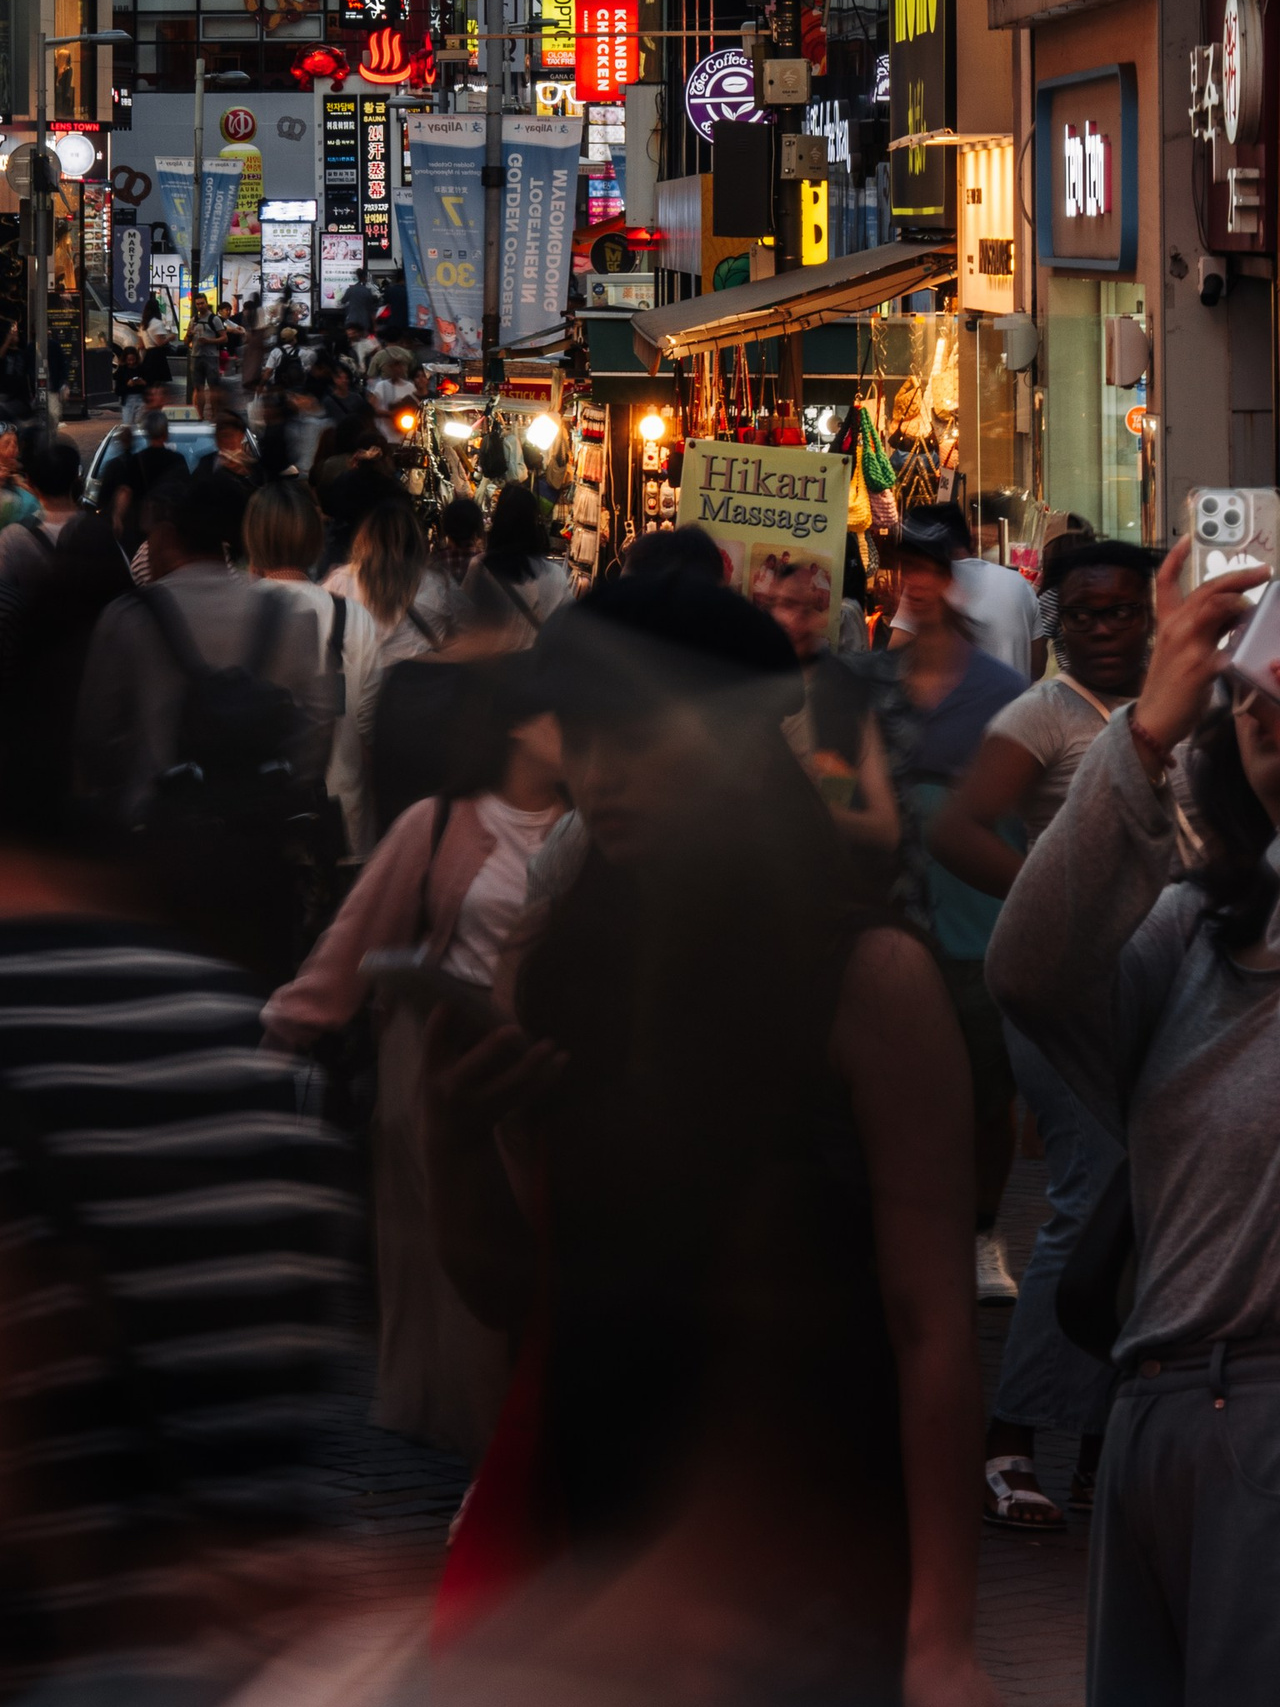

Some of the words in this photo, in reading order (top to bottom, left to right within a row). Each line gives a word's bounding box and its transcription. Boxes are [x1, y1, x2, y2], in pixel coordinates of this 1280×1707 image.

[596, 8, 610, 91] CHICKEN
[614, 8, 627, 82] KKANBU
[689, 71, 709, 96] The
[705, 52, 748, 74] Coffee
[326, 102, 355, 112] 전자담배
[363, 102, 386, 114] 황금
[363, 115, 387, 123] SAUNA
[51, 122, 72, 132] LENS
[73, 122, 100, 132] TOWN
[227, 113, 253, 139] ゆ
[365, 224, 388, 238] 사우나
[127, 231, 137, 300] MARTYVAPE
[508, 391, 536, 400] STICK
[698, 454, 829, 503] Hikari
[698, 494, 829, 538] Massage
